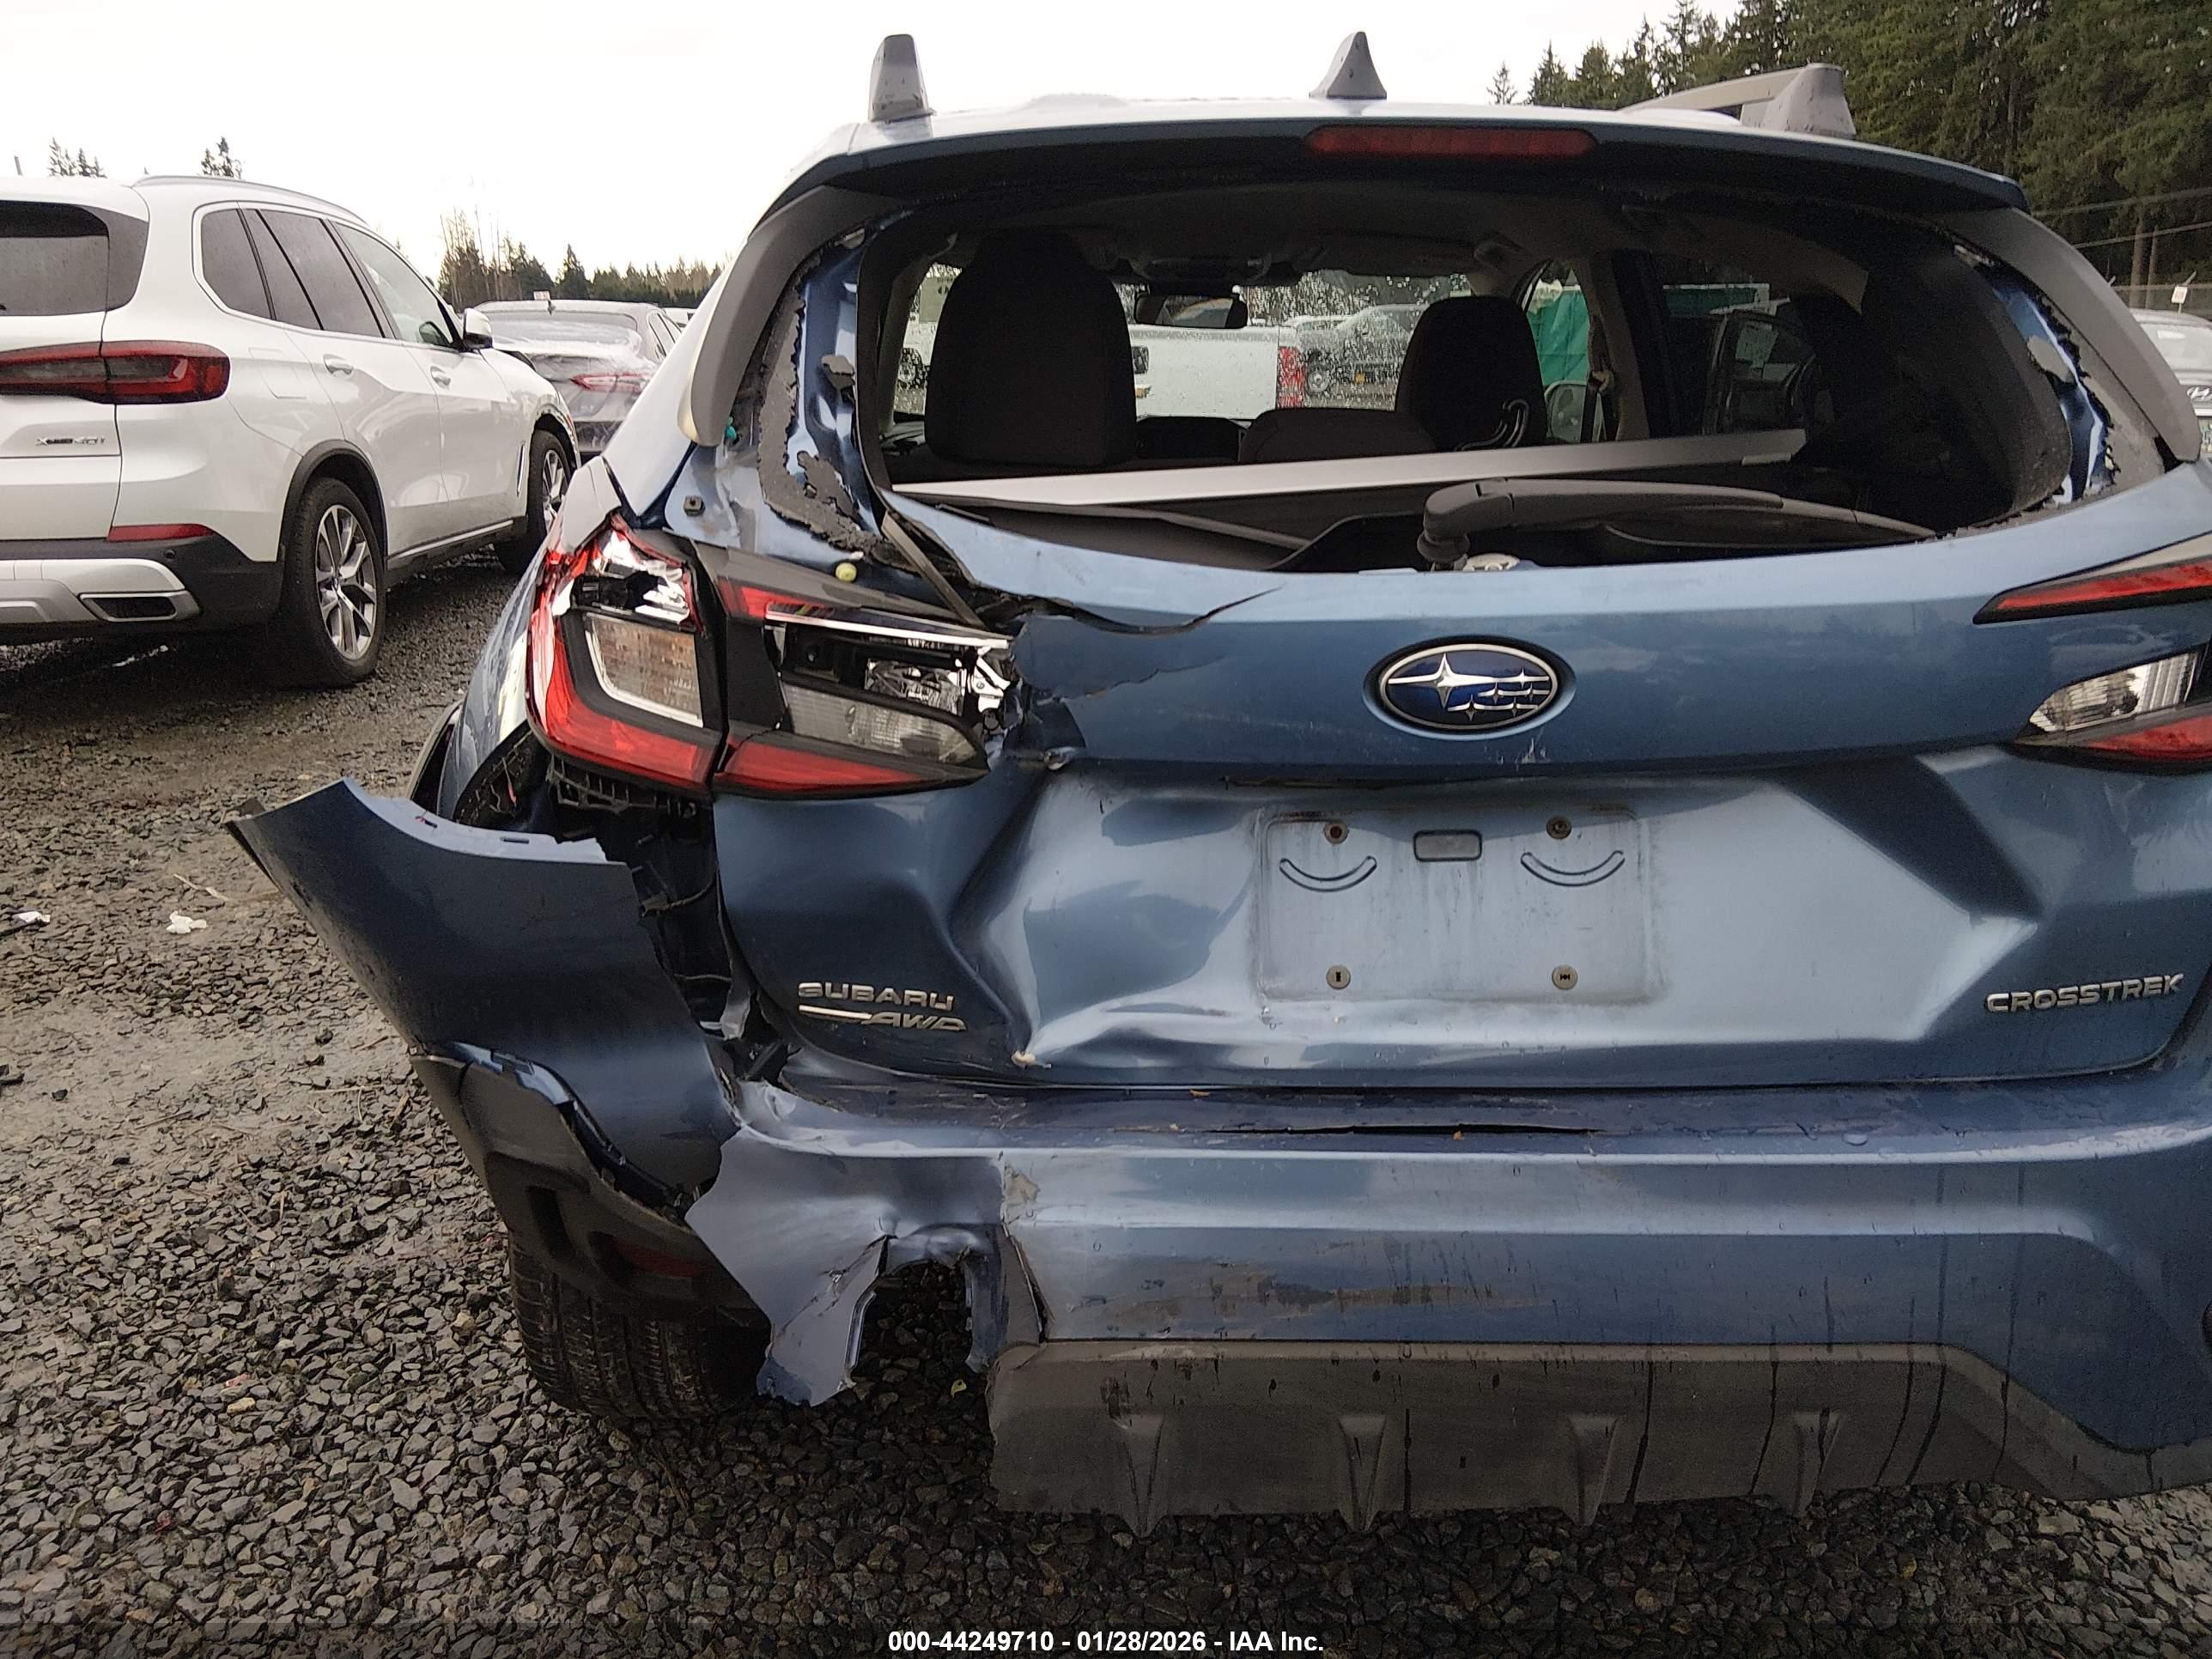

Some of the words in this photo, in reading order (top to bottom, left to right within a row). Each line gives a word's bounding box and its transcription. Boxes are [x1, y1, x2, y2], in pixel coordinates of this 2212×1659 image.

[798, 981, 954, 1012] SUBARU
[1986, 973, 2185, 1013] CROSSTREK
[861, 1011, 967, 1031] AWD
